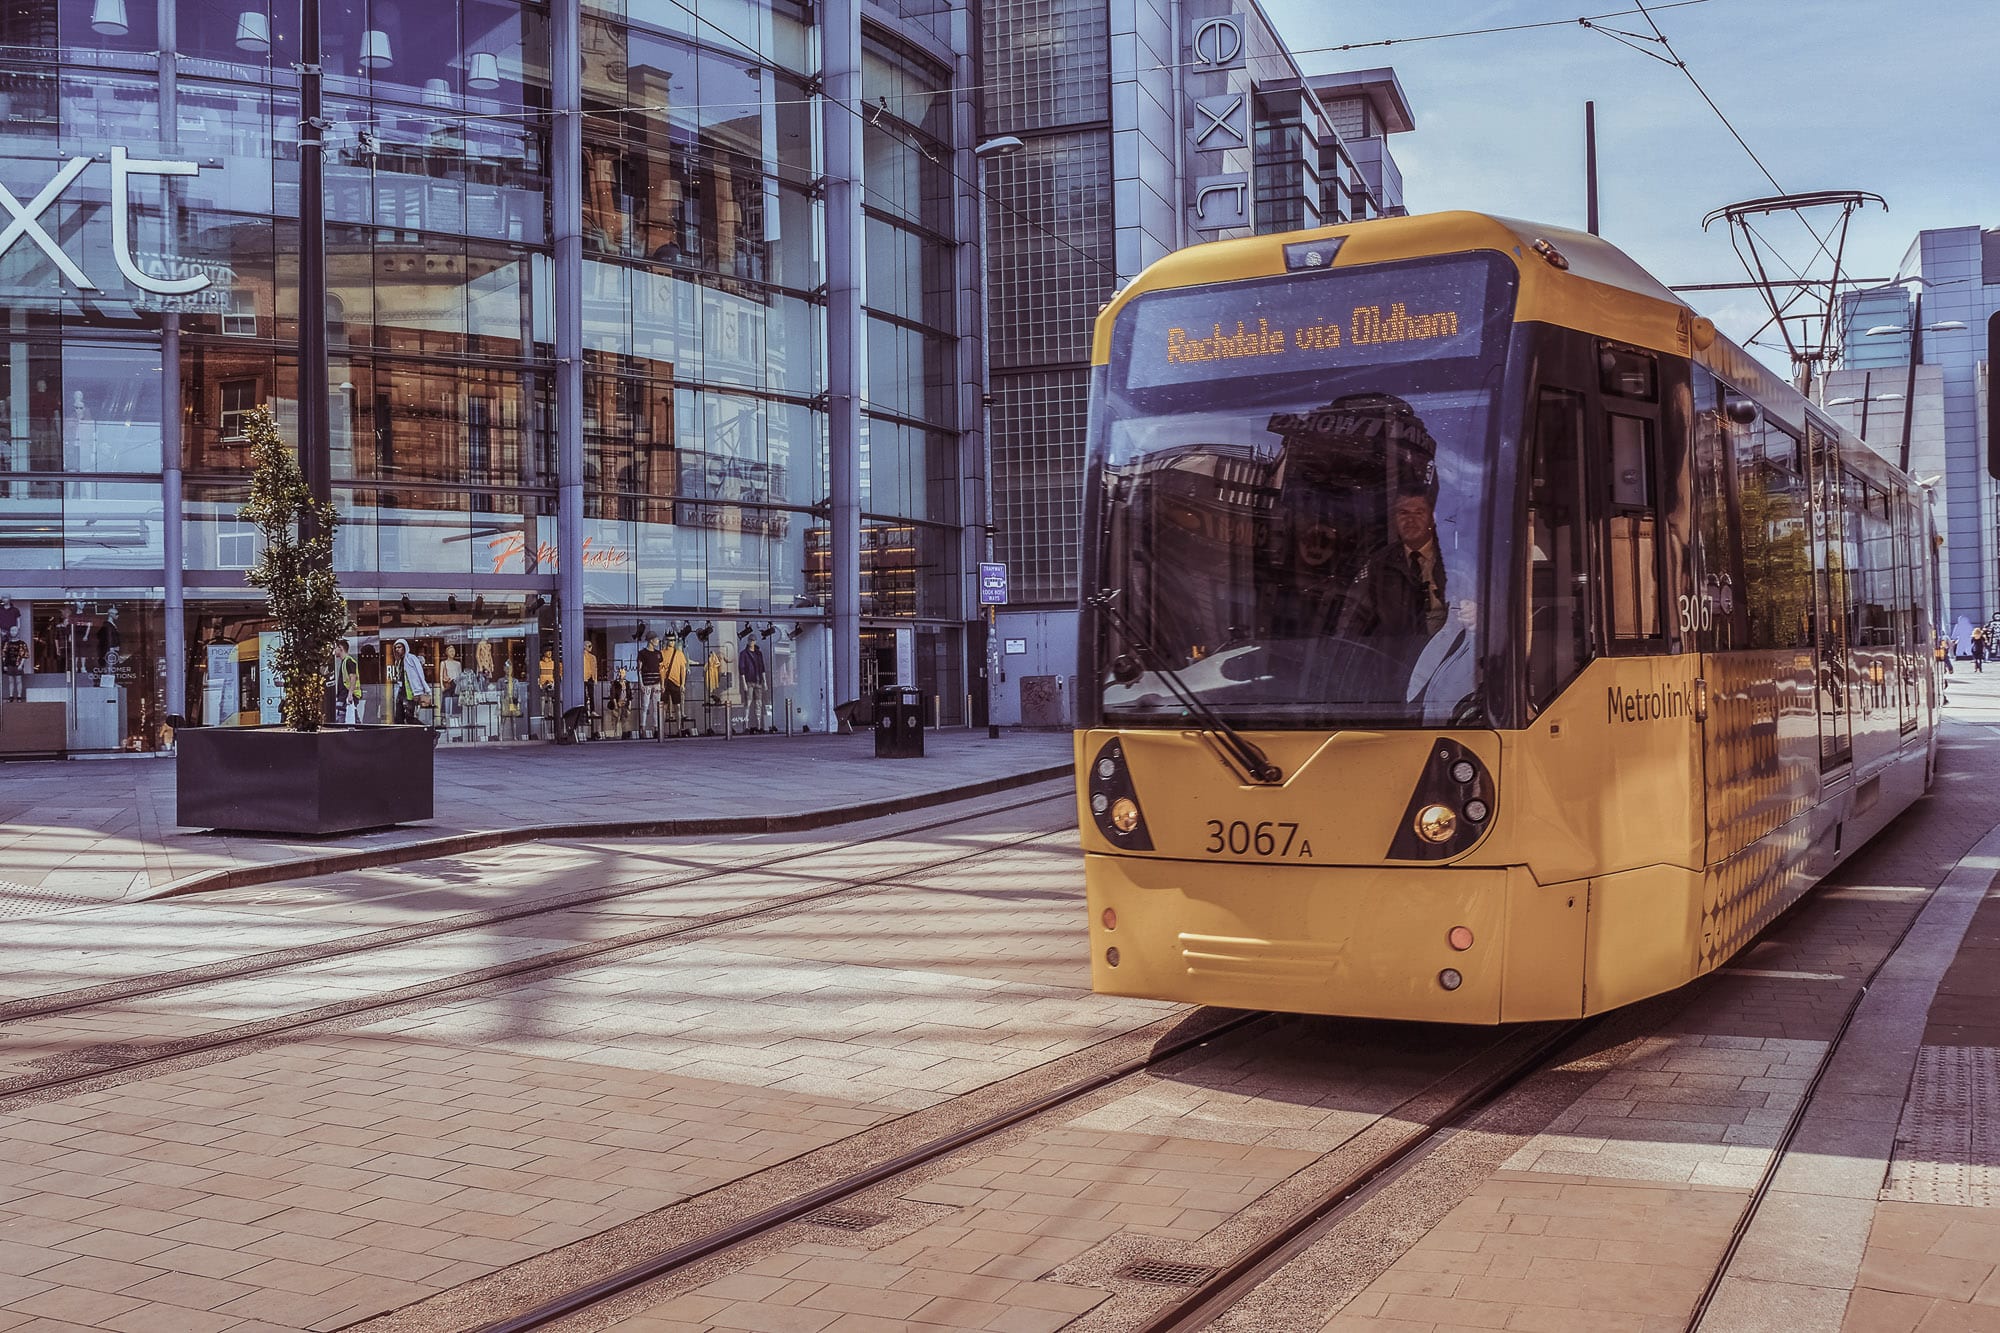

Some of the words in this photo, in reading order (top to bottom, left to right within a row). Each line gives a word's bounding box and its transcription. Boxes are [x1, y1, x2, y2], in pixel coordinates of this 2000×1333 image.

[1168, 317, 1285, 364] Rochdale
[1296, 317, 1341, 349] via
[1351, 302, 1457, 345] Oldham
[1679, 594, 1713, 632] 3067
[1608, 681, 1693, 724] Metrolink
